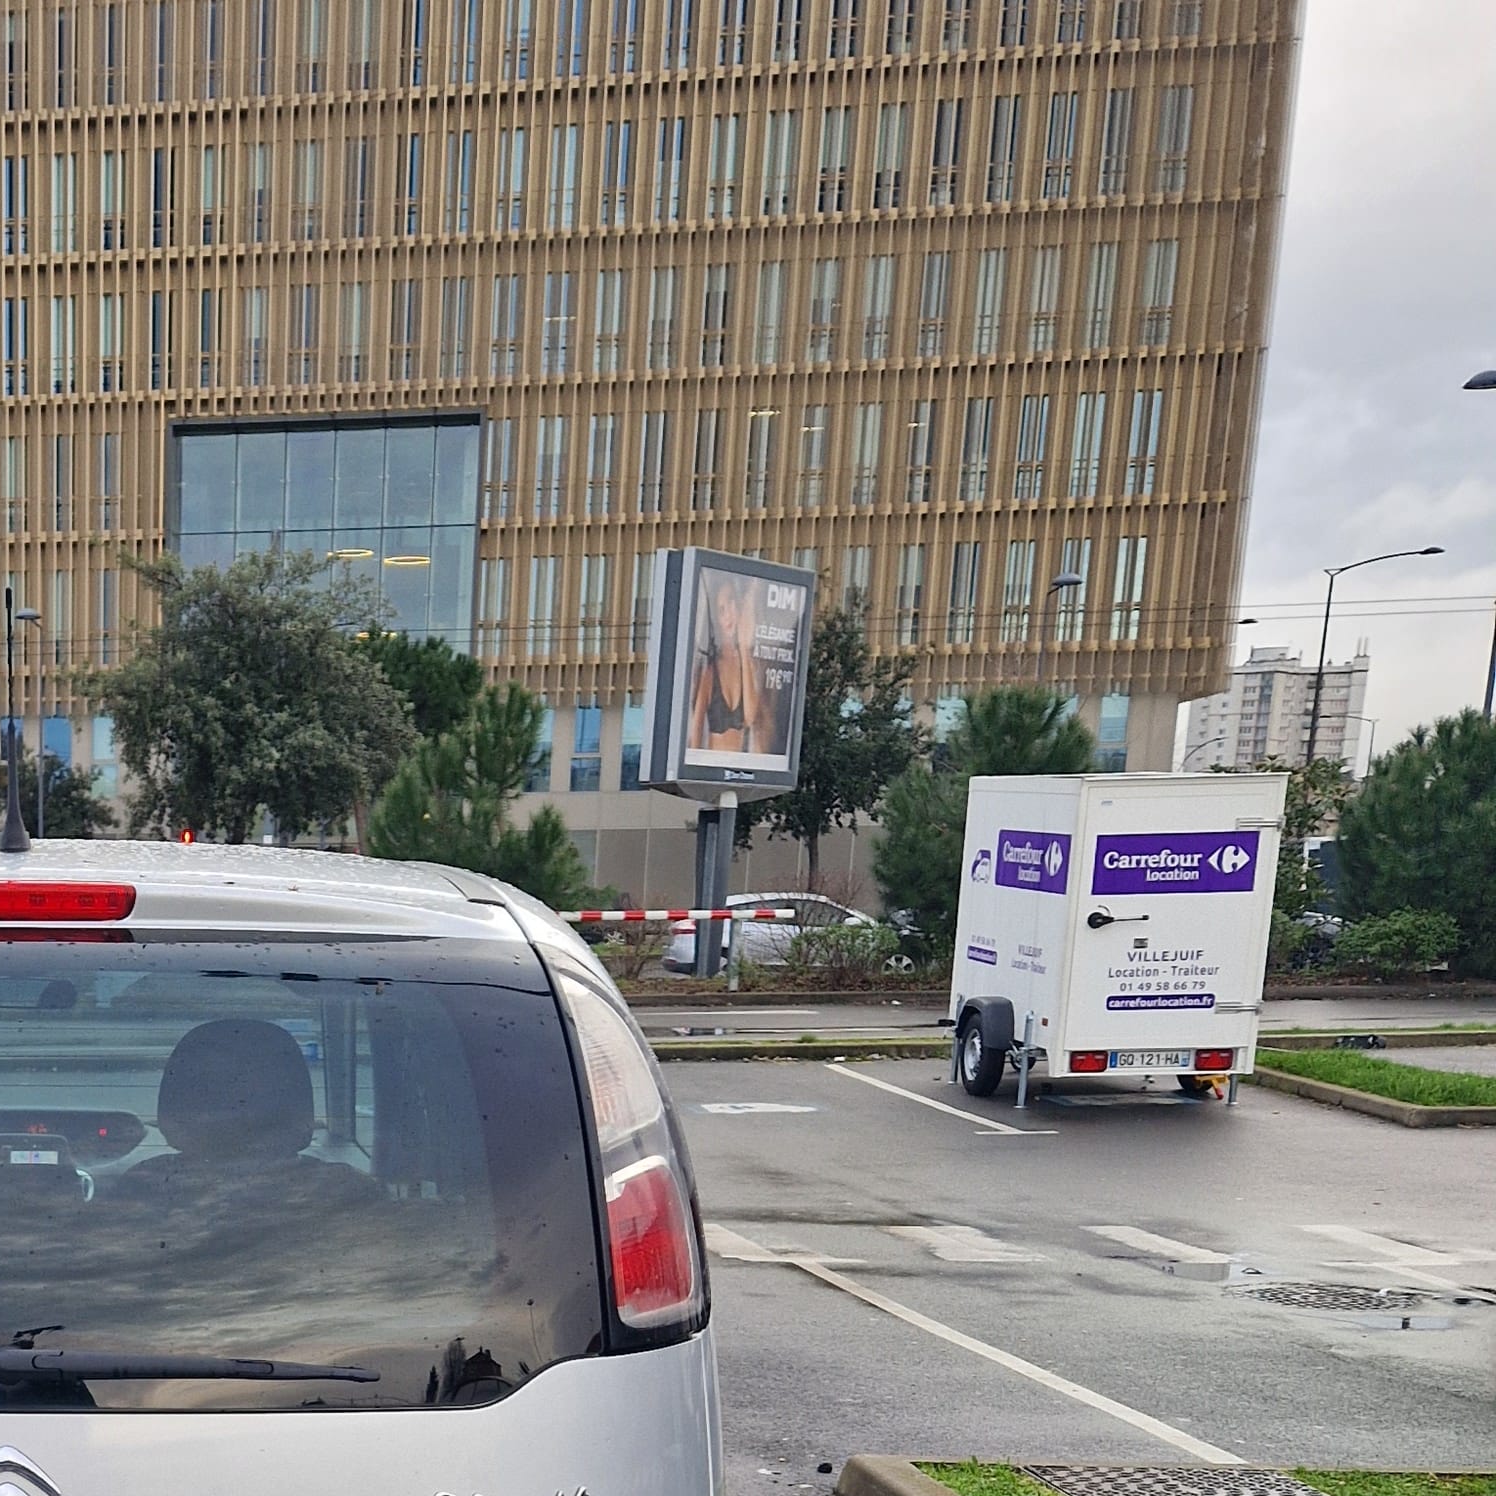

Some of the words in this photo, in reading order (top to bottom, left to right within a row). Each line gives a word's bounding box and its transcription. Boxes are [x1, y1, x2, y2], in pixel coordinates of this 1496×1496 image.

[767, 584, 797, 611] DIM
[1003, 840, 1044, 865] Carrefour
[1104, 849, 1202, 869] Carrefour
[1146, 868, 1199, 882] location
[1127, 950, 1204, 962] VILLEJUIF
[1108, 967, 1159, 978] Location
[1171, 966, 1219, 976] Traiteur
[1120, 983, 1133, 991] 01
[1138, 982, 1152, 991] 49
[1156, 982, 1170, 991] 58
[1173, 982, 1187, 990] 66
[1192, 981, 1206, 989] 79
[1108, 996, 1213, 1008] carrefourlocation.fr
